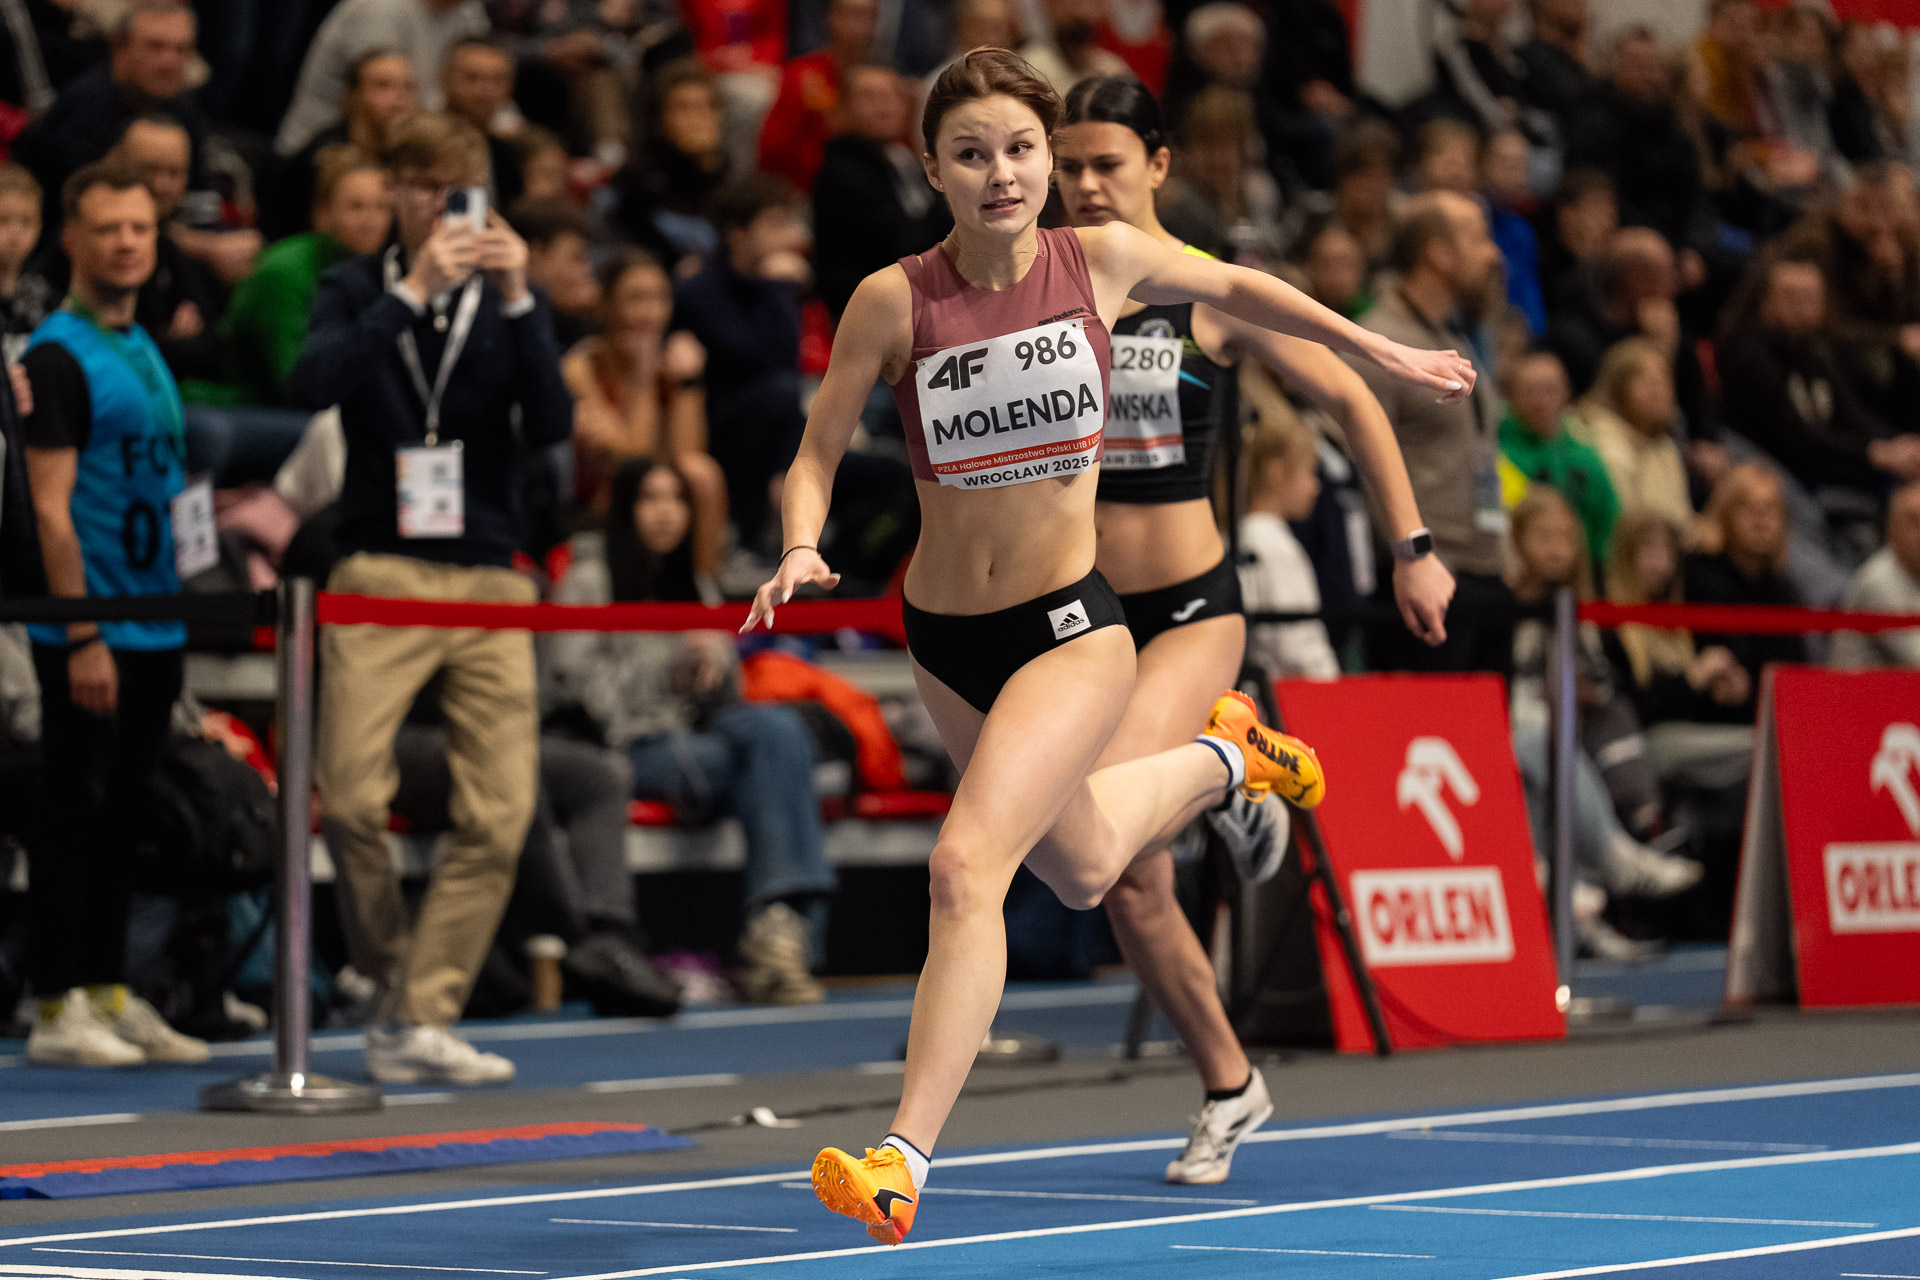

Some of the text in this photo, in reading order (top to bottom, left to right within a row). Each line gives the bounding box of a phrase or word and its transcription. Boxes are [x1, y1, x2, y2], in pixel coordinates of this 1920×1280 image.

[1038, 307, 1084, 326] new balance
[1015, 331, 1077, 371] 986
[928, 347, 989, 391] 4F
[932, 383, 1099, 445] MOLENDA
[1107, 394, 1173, 420] WSKA
[938, 464, 958, 473] PZLA
[960, 459, 992, 471] Halowe
[993, 449, 1045, 464] Mistrzostwa
[1046, 443, 1072, 454] Polski
[1073, 440, 1088, 450] U18
[963, 456, 1089, 487] WROCŁAW 2025
[1058, 618, 1085, 632] adidas
[1369, 885, 1497, 947] ORLEN
